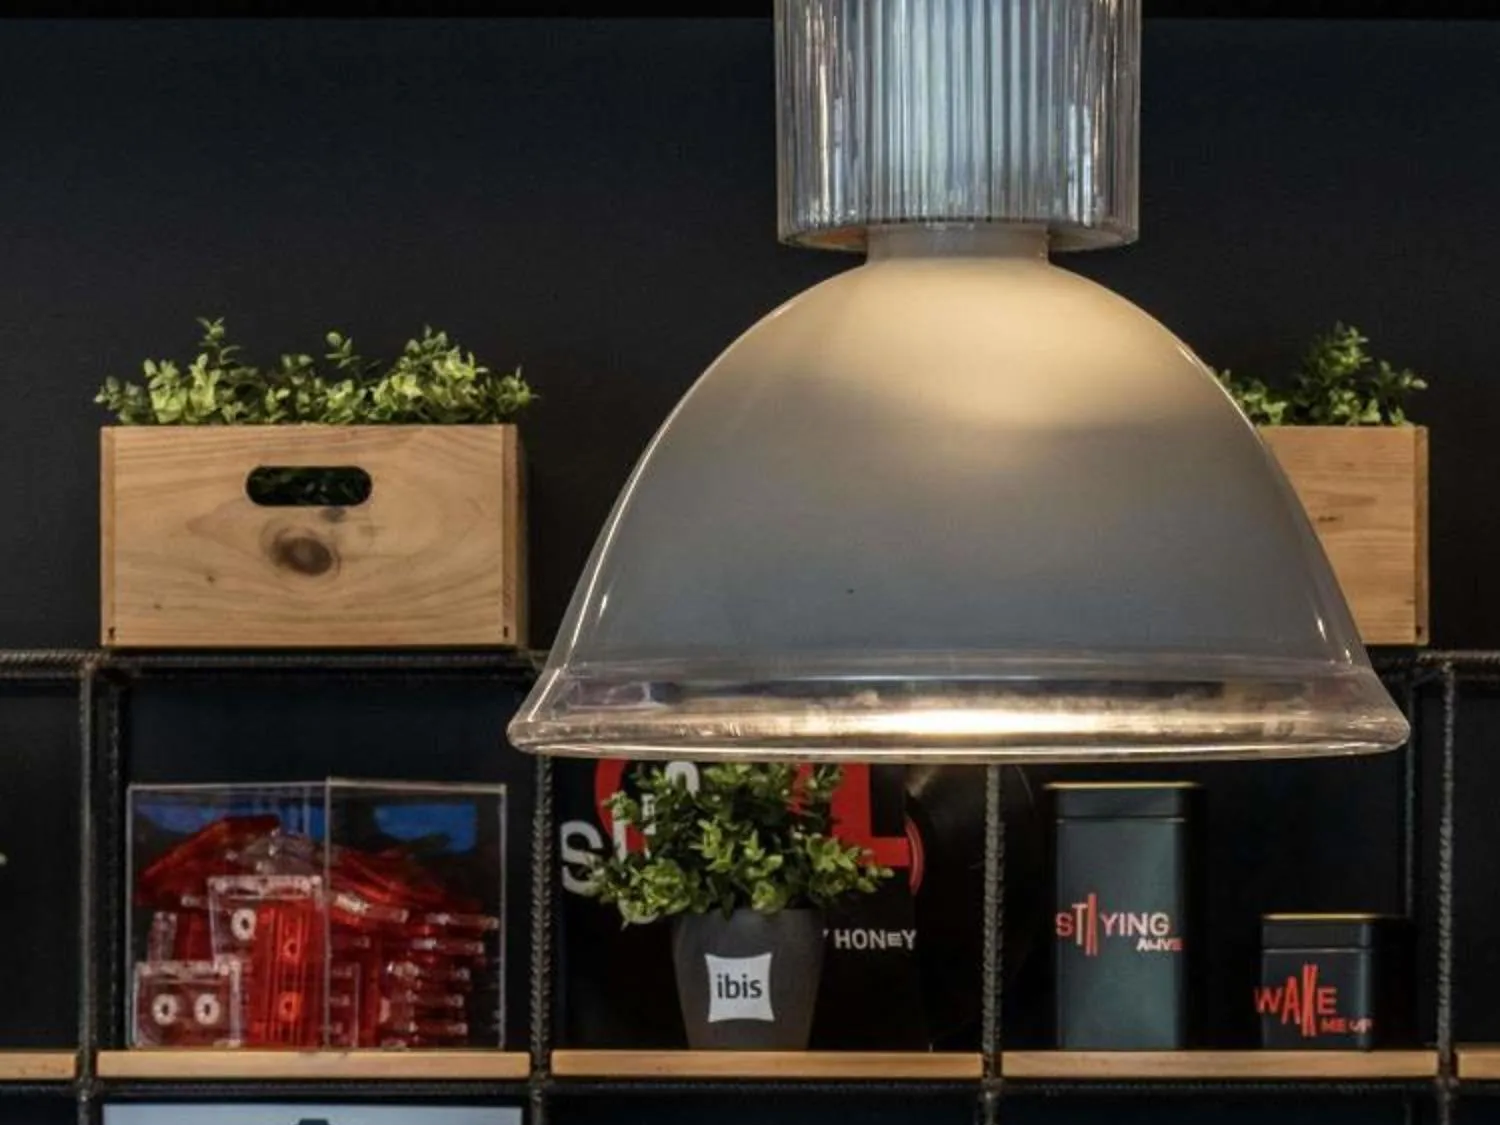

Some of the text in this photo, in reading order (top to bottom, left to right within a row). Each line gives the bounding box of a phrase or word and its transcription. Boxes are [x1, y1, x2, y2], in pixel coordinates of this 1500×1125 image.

[834, 928, 917, 951] HONEY
[1056, 893, 1170, 955] STAYING
[716, 974, 762, 999] ibis
[1254, 963, 1337, 1036] WAKE
